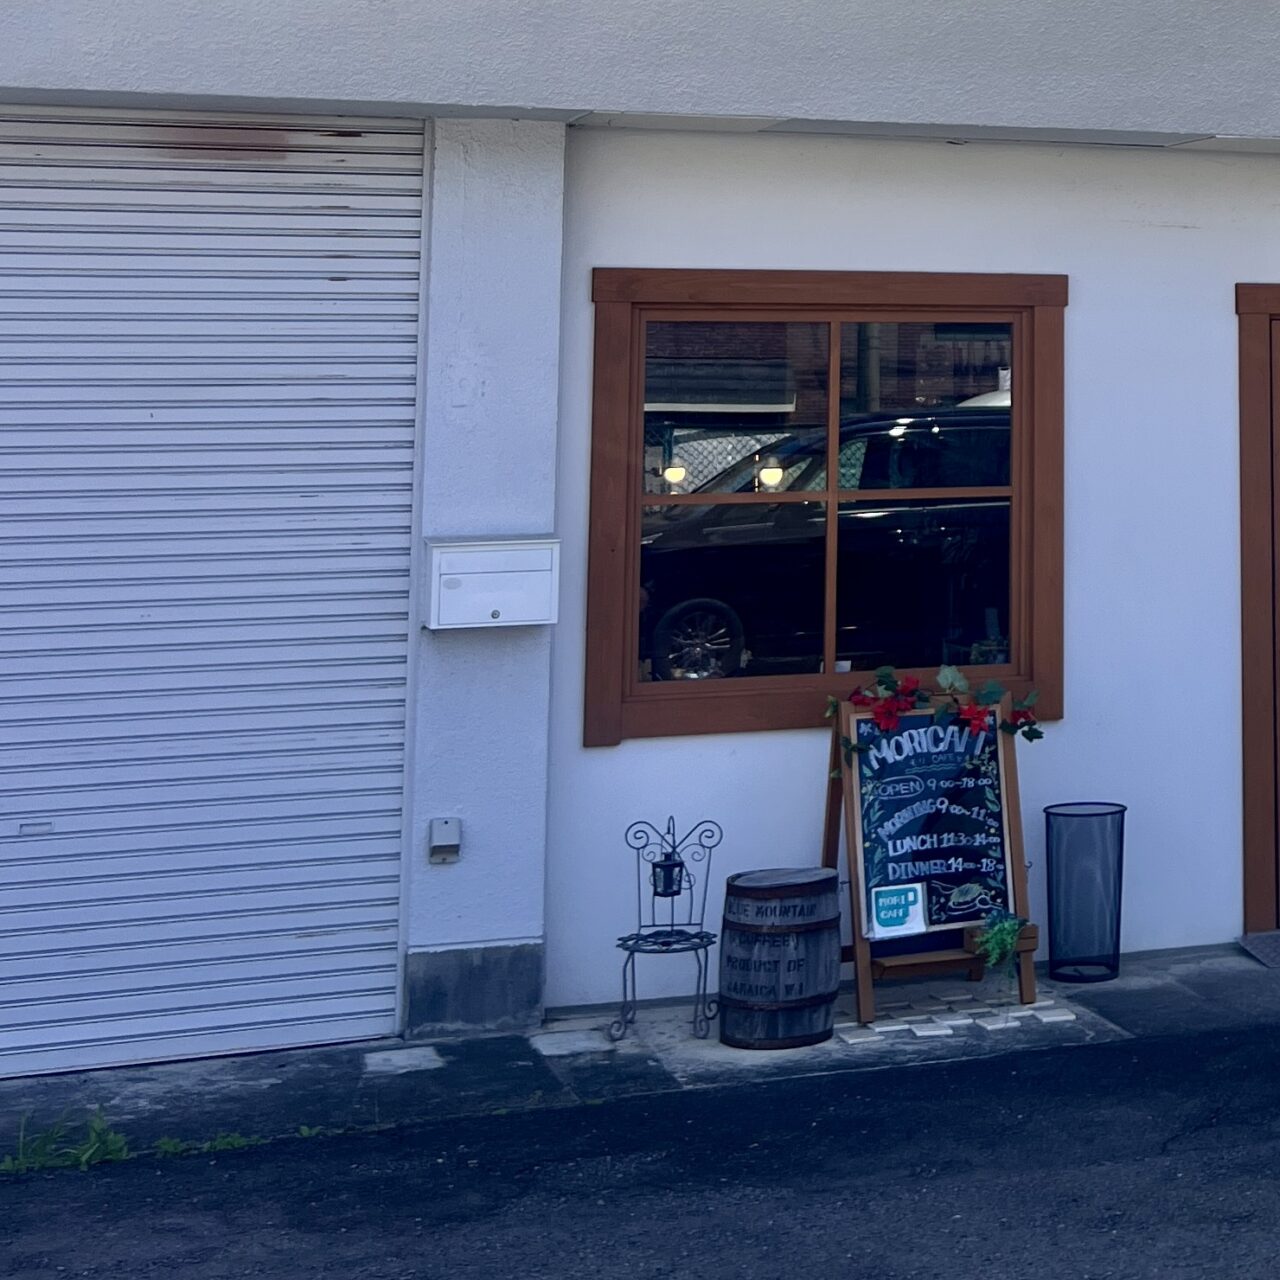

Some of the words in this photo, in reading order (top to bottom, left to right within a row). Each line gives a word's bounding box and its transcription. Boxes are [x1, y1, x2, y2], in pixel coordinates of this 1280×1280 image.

[879, 781, 920, 796] OPEN
[878, 799, 936, 840] MORNING
[887, 833, 938, 857] LUNCH
[887, 860, 947, 880] DINNER
[787, 958, 806, 973] OF
